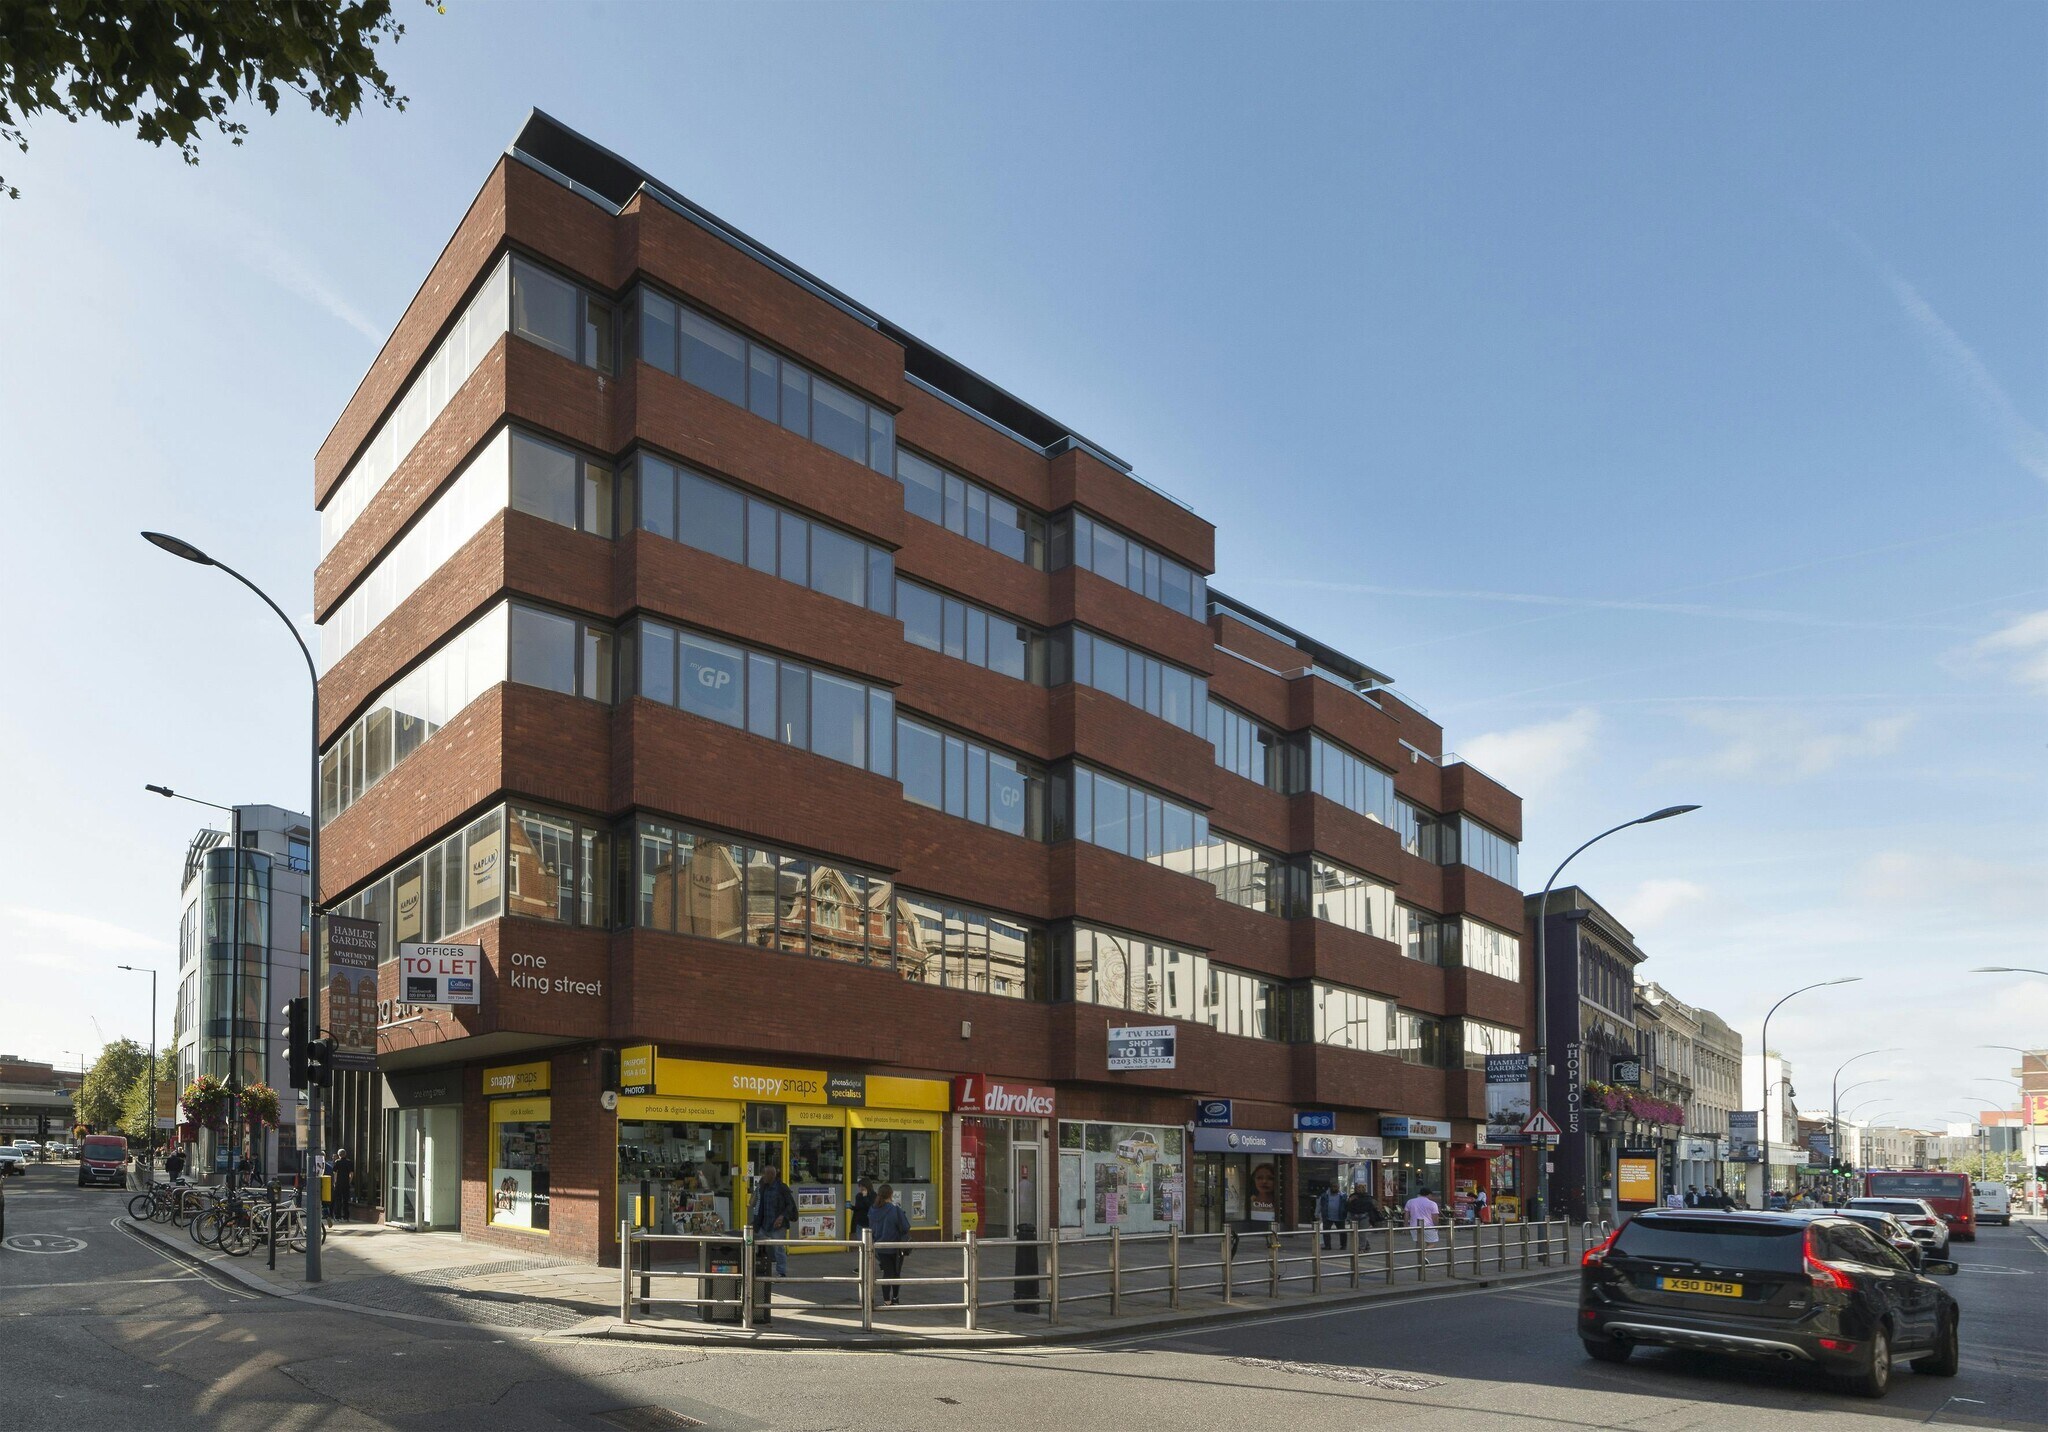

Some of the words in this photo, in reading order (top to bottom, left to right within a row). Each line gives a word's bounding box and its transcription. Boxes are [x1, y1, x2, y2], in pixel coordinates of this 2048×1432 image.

[698, 667, 730, 689] GP
[1001, 786, 1020, 808] GP
[473, 852, 496, 871] KAPLAN
[400, 895, 417, 910] KAPLAN
[334, 926, 374, 939] HAMLET
[331, 935, 377, 949] GARDENS
[334, 951, 375, 961] APARTMENTS
[417, 946, 464, 957] OFFICES
[404, 957, 431, 974] TO
[439, 959, 477, 975] LET
[511, 952, 547, 969] one
[511, 969, 549, 995] king
[554, 976, 602, 996] street
[1126, 1030, 1143, 1038] TW
[1145, 1029, 1171, 1037] KEIL
[1118, 1048, 1137, 1057] TO
[1140, 1046, 1164, 1057] LET
[623, 1058, 646, 1067] PASSPORT
[1132, 1057, 1149, 1065] 883
[1567, 1049, 1579, 1079] HOP
[624, 1086, 645, 1095] PHOTOS
[831, 1089, 862, 1098] specialists
[962, 1078, 976, 1103] L
[984, 1085, 1054, 1114] dbrokes
[645, 1105, 662, 1113] photo
[670, 1106, 687, 1115] digital
[1568, 1083, 1579, 1133] POLES
[1241, 1135, 1267, 1147] Opticians
[1652, 1265, 1744, 1278] VOLVO
[1671, 1279, 1700, 1291] X90
[1704, 1283, 1733, 1294] DMB
